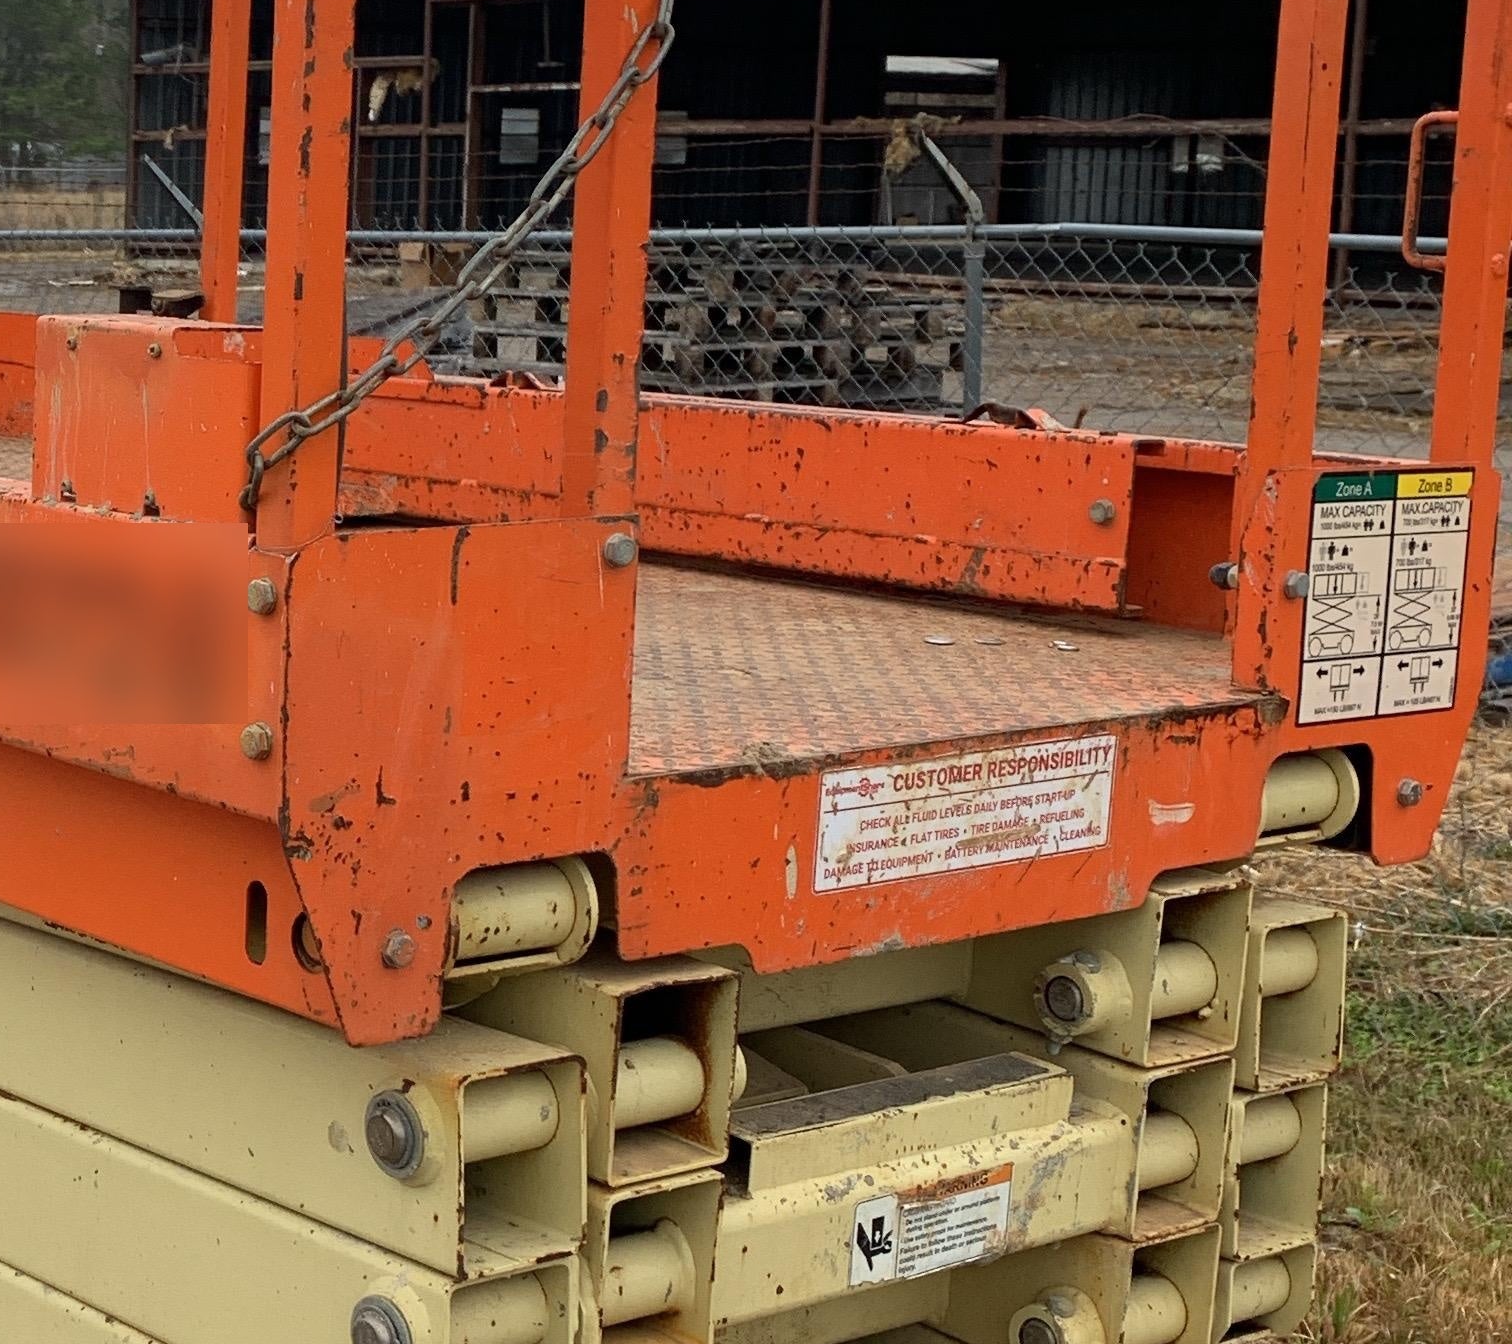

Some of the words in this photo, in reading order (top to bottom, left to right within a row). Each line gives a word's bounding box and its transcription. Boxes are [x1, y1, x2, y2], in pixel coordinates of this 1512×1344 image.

[1335, 482, 1363, 497] Zone
[1363, 481, 1374, 496] A
[1418, 479, 1443, 494] Zone
[1444, 477, 1453, 492] B
[1320, 505, 1340, 518] MAX
[1342, 503, 1387, 517] CAPACITY
[1401, 502, 1420, 515] MAX
[1421, 500, 1465, 514] CAPACITY
[893, 763, 982, 792] CUSTOMER
[988, 744, 1113, 778] RESPONSIBILITY
[860, 816, 891, 831] CHECK
[912, 810, 938, 824] FLUID
[939, 804, 972, 820] LEVELS
[973, 799, 998, 813] DAILY
[1000, 795, 1033, 810] BEFORE
[1034, 789, 1076, 806] START-UP
[846, 836, 899, 853] INSURANCE
[910, 831, 932, 844] FLAT
[935, 827, 960, 841] TIRES
[971, 822, 990, 835] TIRE
[992, 816, 1029, 832] DAMAGE
[1039, 808, 1085, 825] REFUELING
[824, 862, 864, 880] DAMAGE
[881, 851, 934, 870] EQUIPMENT
[944, 843, 984, 860] BATTERY
[986, 834, 1049, 853] MAINTENANCE
[1059, 825, 1101, 842] CLEANING
